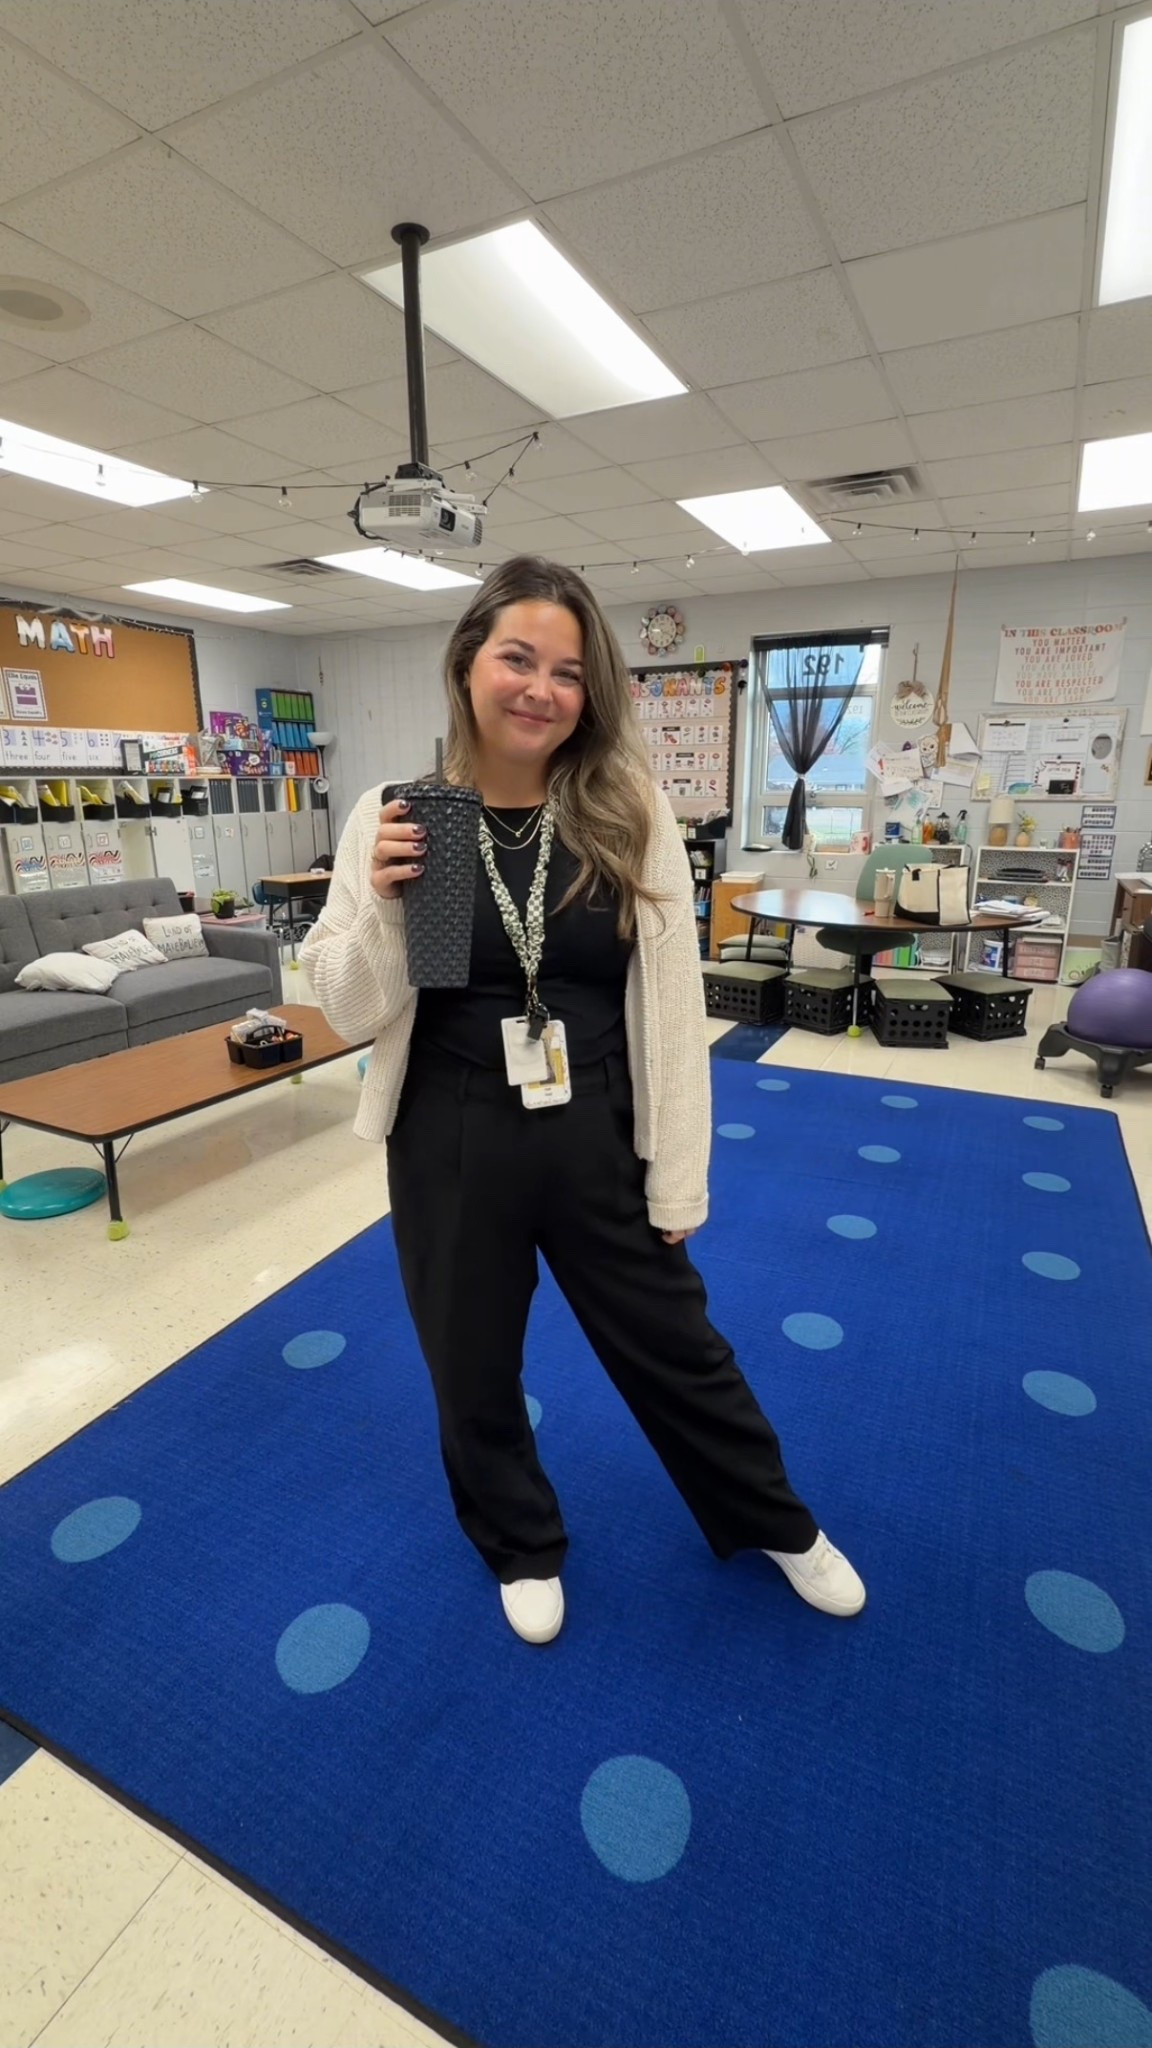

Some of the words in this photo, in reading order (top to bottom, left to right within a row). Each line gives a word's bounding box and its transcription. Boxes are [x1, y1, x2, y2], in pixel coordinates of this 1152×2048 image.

[15, 614, 116, 658] MATH
[1004, 629, 1017, 637] IN
[1020, 629, 1047, 638] THIS
[1050, 623, 1123, 637] CLASSROOM
[1032, 639, 1050, 647] YOU
[1054, 636, 1086, 646] MATTER
[1015, 647, 1031, 656] YOU
[1035, 646, 1050, 655] ARE
[1055, 643, 1106, 655] IMPORTANT
[1025, 656, 1041, 664] YOU
[1045, 655, 1061, 663] ARE
[1065, 653, 1093, 662] LOVED
[1015, 680, 1031, 688] YOU
[1035, 679, 1051, 688] ARE
[1055, 676, 1104, 688] RESPECTED
[3, 729, 12, 746] 3
[32, 730, 45, 747] 4
[60, 731, 69, 747] 5
[87, 731, 95, 748] 6
[6, 750, 28, 761] three
[34, 751, 51, 761] four
[62, 751, 76, 761] five
[88, 753, 99, 761] six
